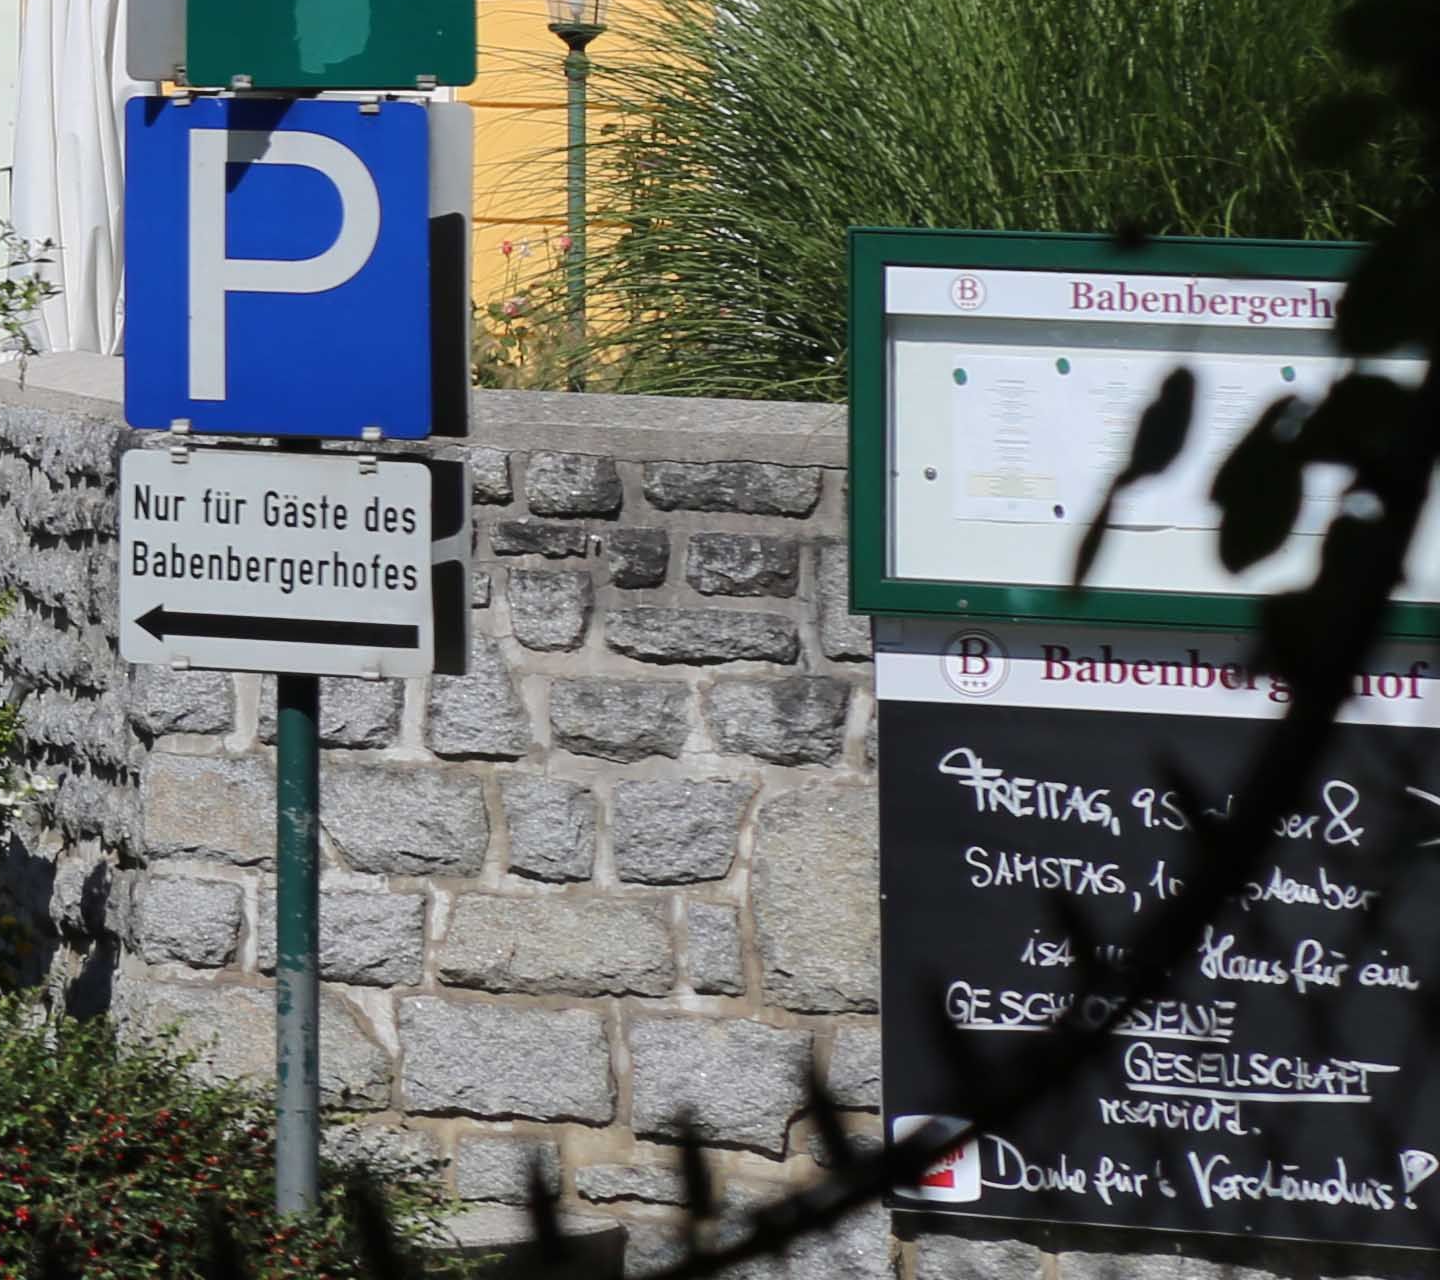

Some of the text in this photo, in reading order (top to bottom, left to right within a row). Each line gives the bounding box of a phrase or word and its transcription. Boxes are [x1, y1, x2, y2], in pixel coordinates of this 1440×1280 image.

[188, 128, 382, 401] P
[1070, 282, 1340, 324] Babenbergerh
[134, 484, 416, 534] Nur für Gäste des
[132, 542, 419, 594] Babenbergerhofes
[959, 638, 992, 677] B
[1322, 780, 1366, 846] &
[1198, 924, 1286, 985] Haus
[1291, 939, 1348, 993] für
[1123, 1042, 1401, 1093] GESELLSCHAFT
[981, 1133, 1086, 1193] Danke
